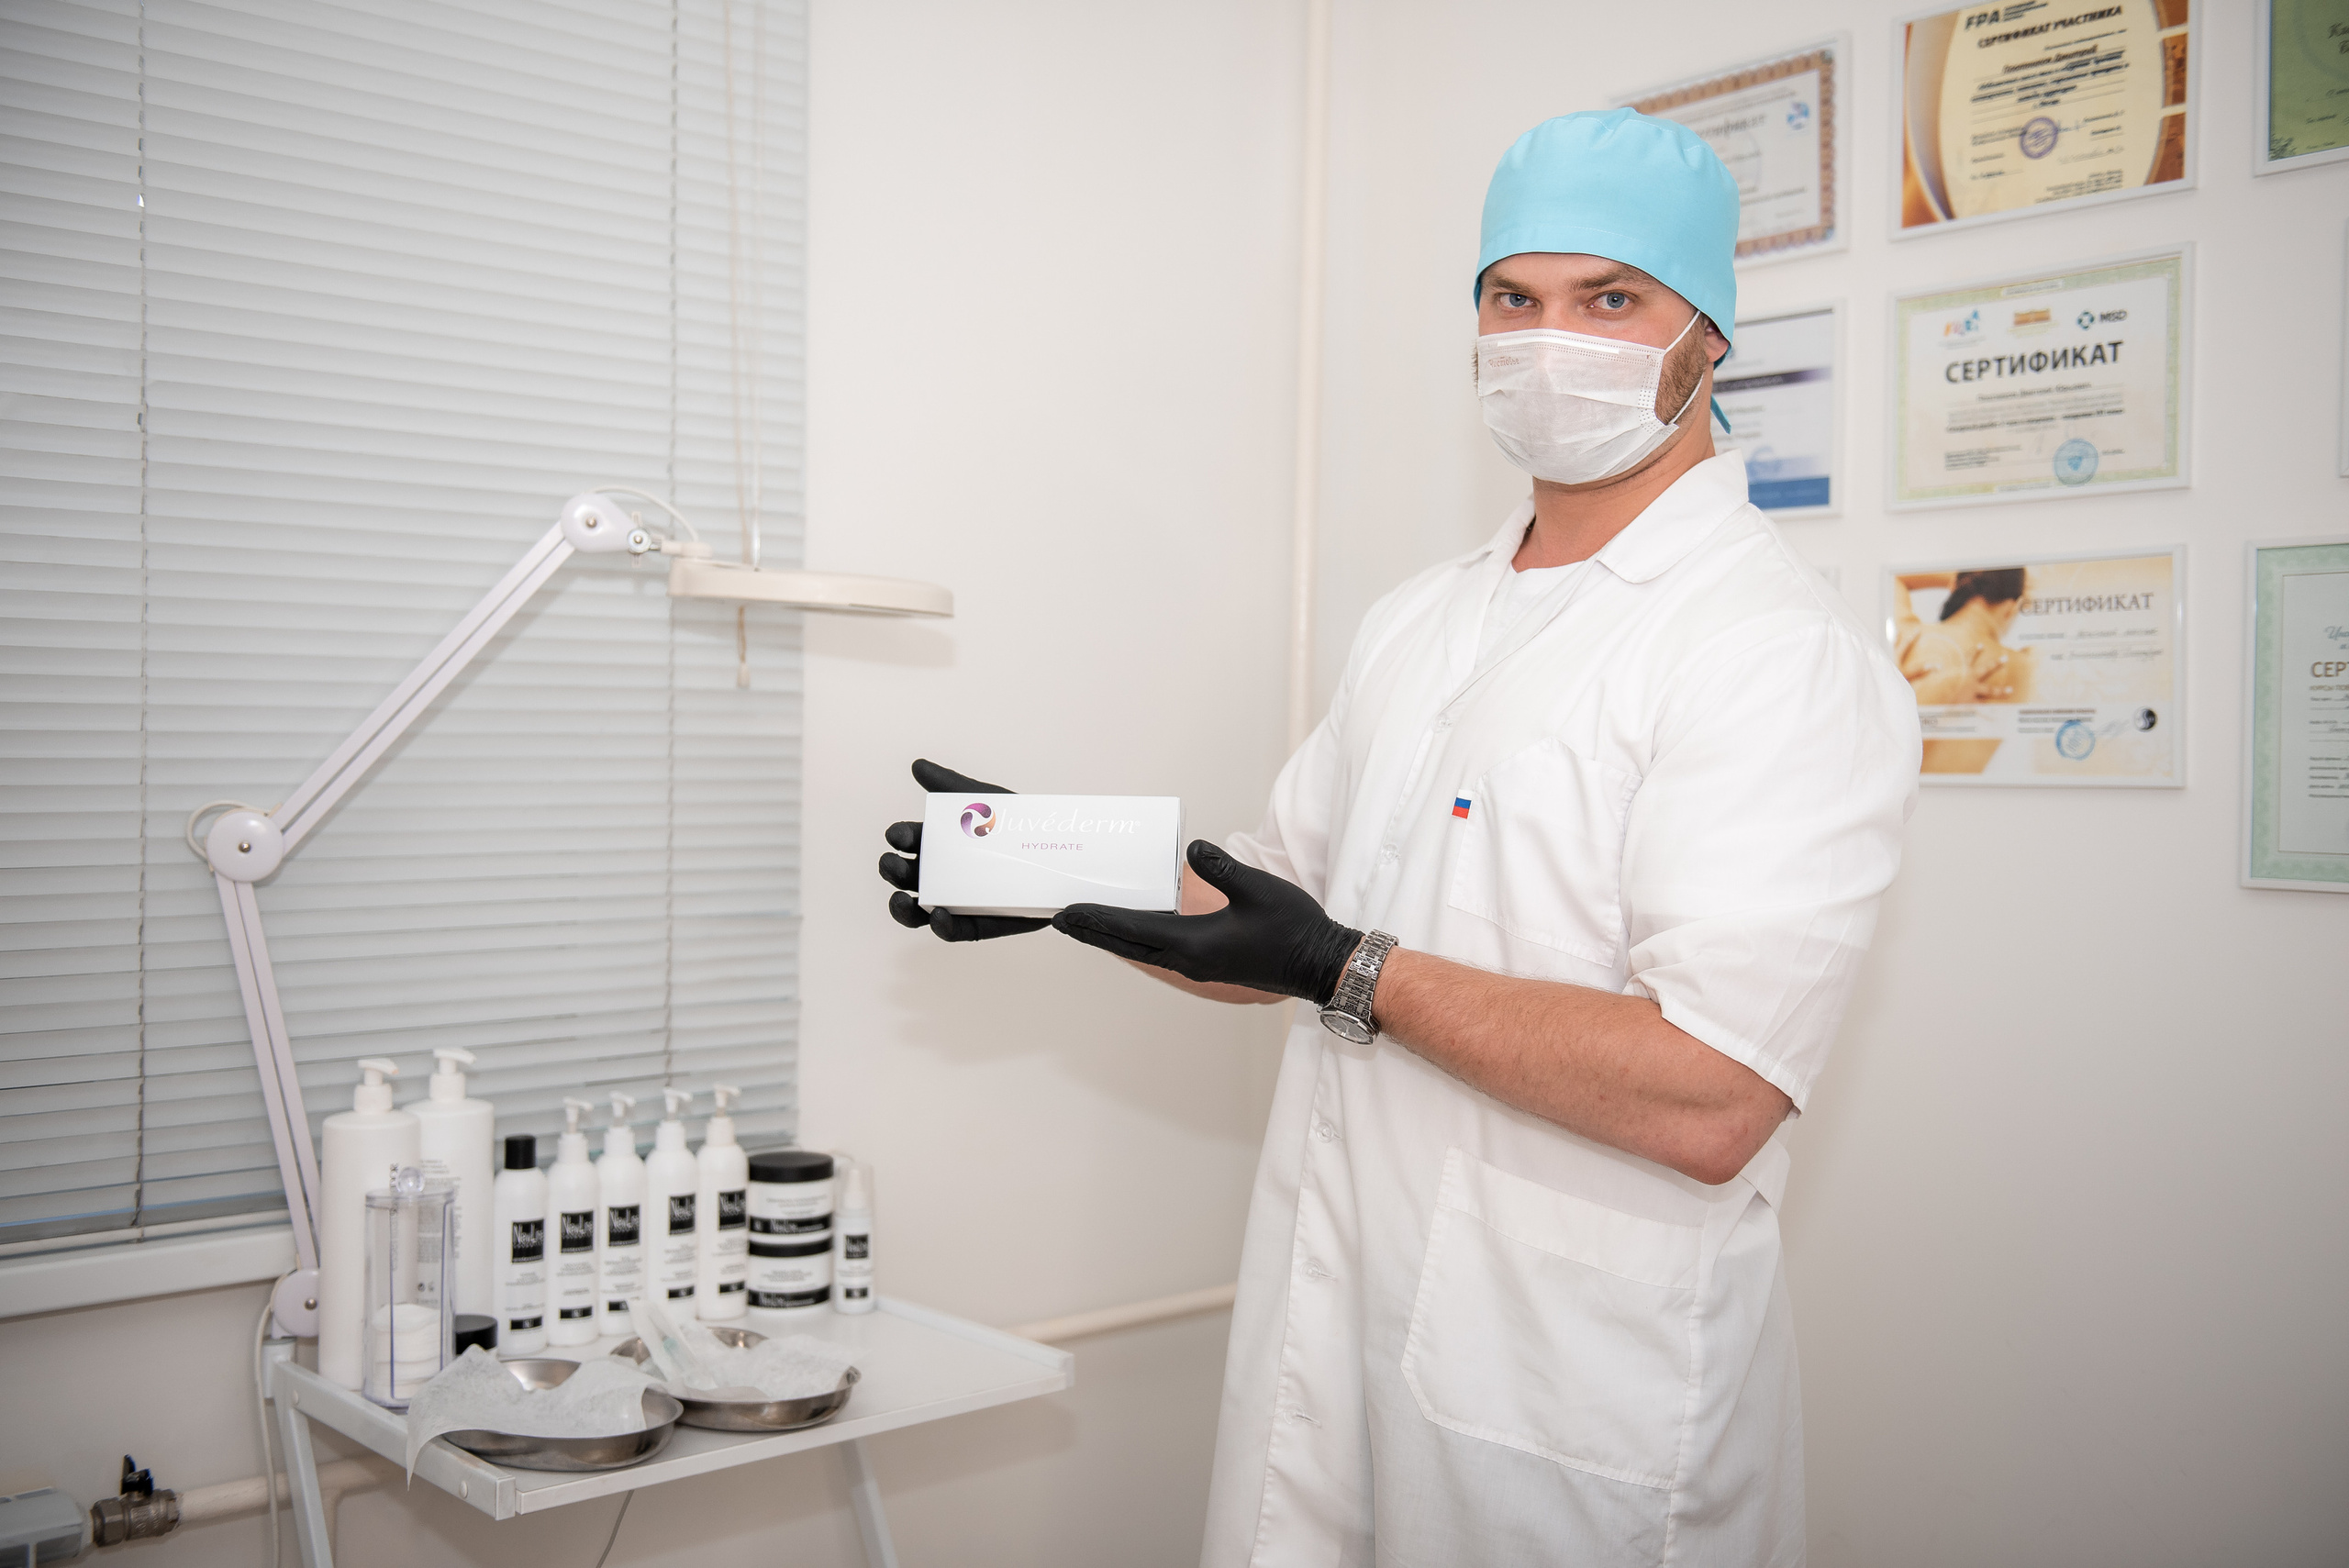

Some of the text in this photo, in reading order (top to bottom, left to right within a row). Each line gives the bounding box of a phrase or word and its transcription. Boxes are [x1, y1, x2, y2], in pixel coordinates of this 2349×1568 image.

[2099, 309, 2129, 323] MSD
[1945, 339, 2125, 384] СЕРТИФИКАТ
[2019, 592, 2154, 617] СЕРТИФИКАТ
[2311, 661, 2349, 678] СЕР
[985, 807, 1136, 835] Juvéderm
[1021, 842, 1084, 851] HYDRATE
